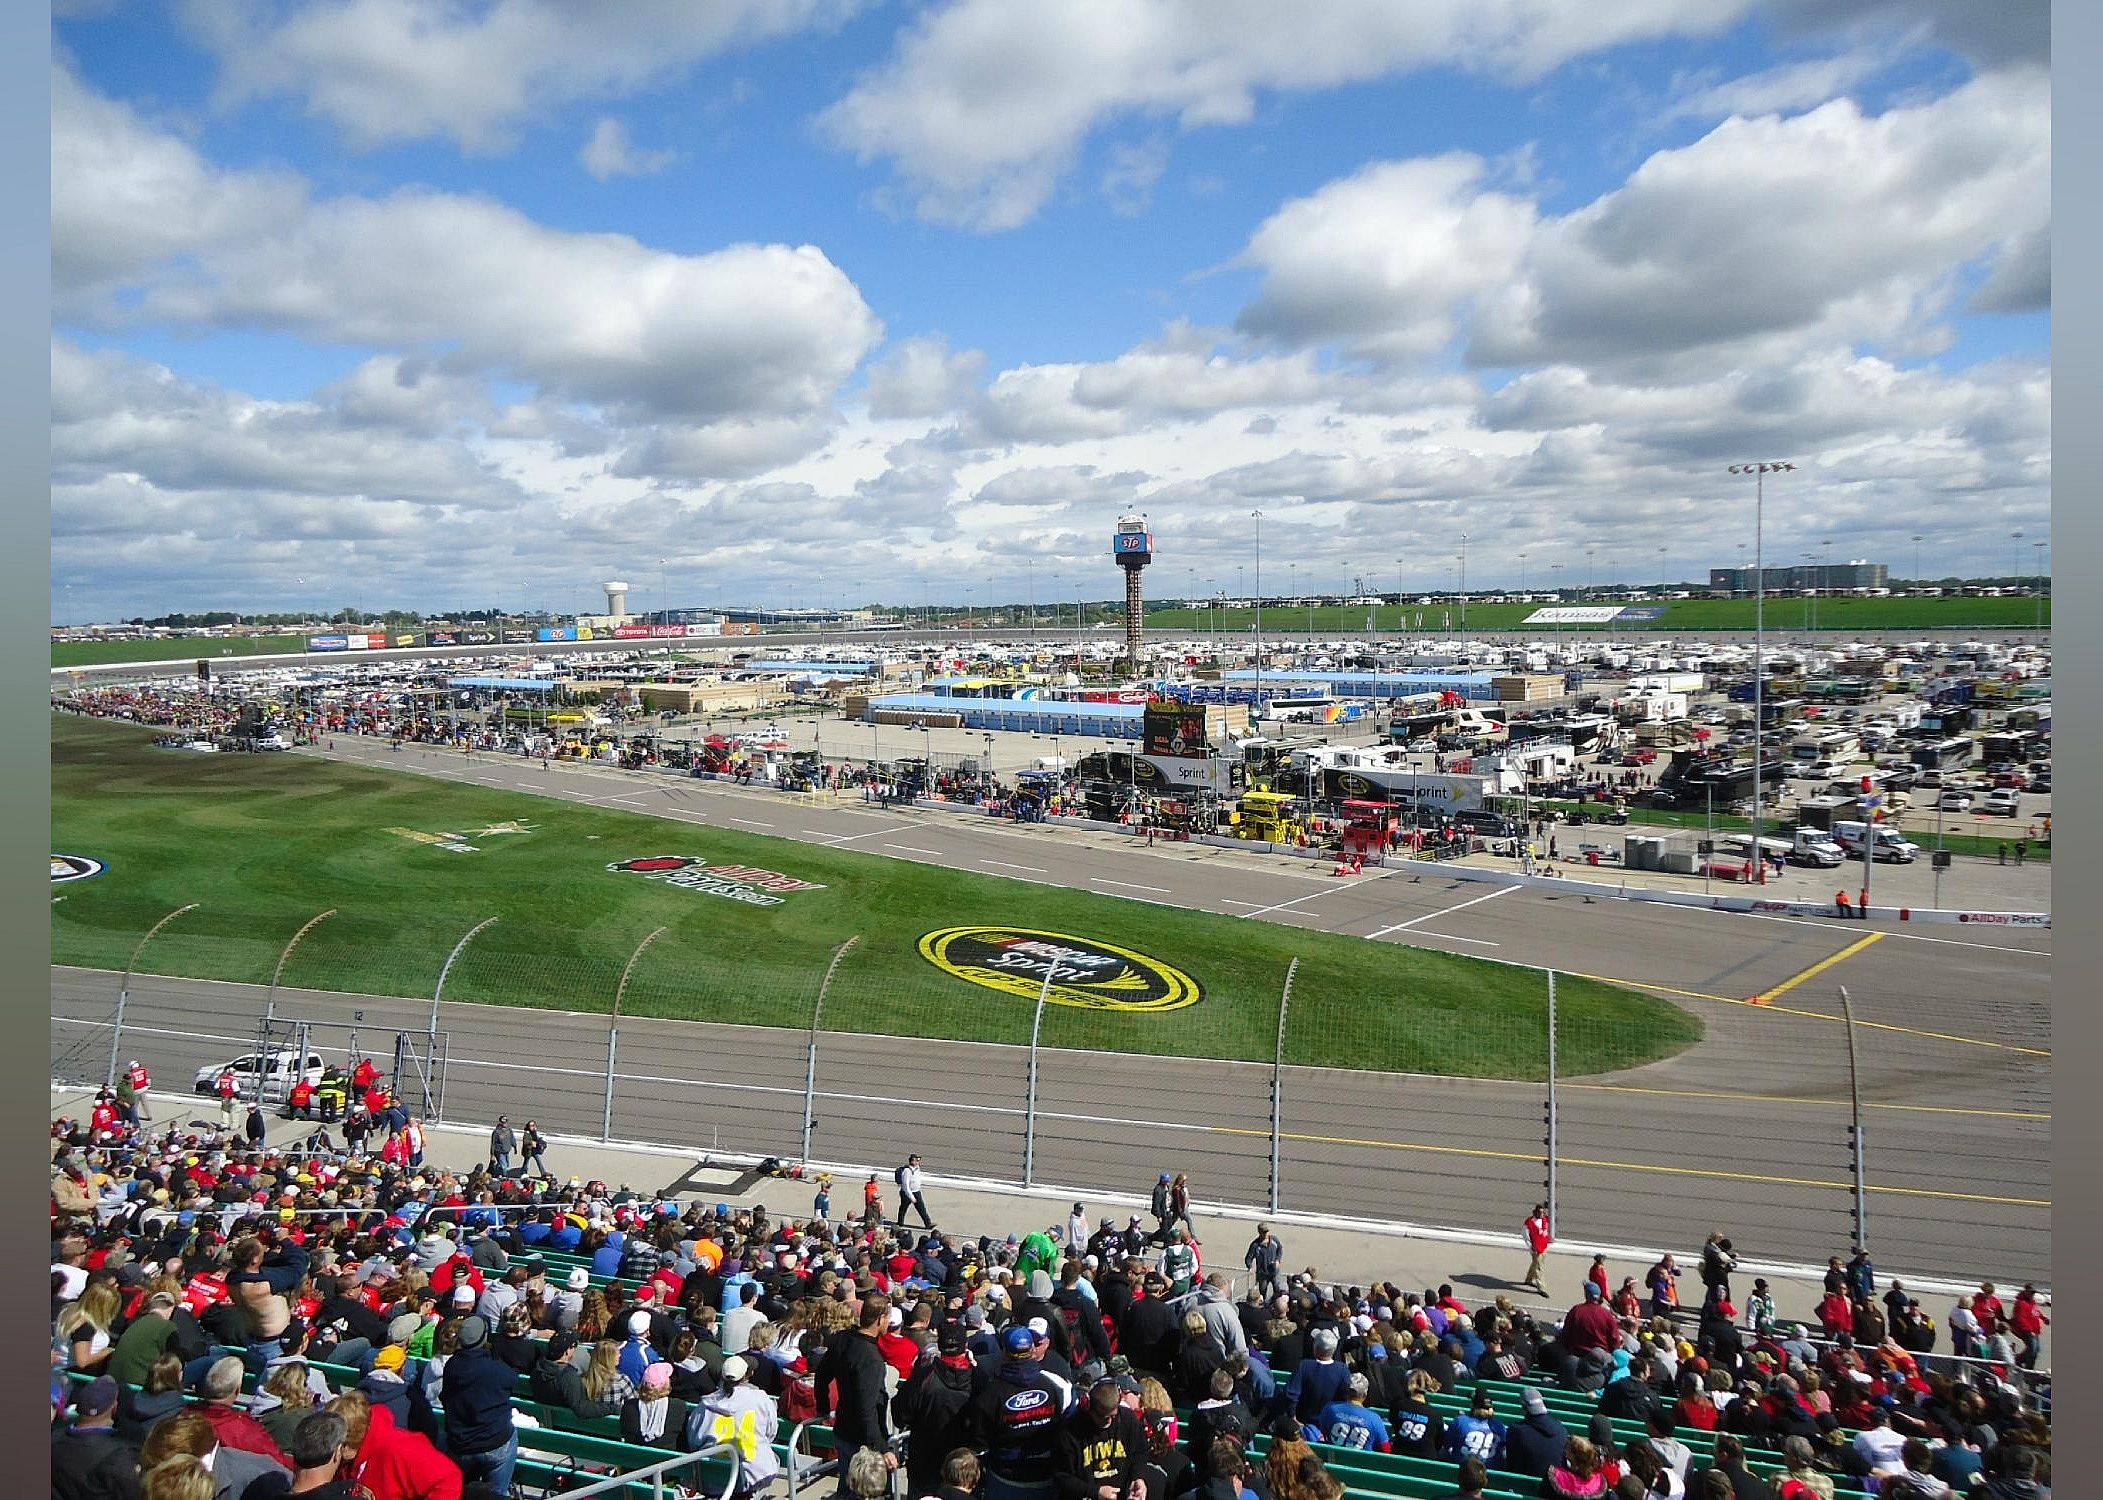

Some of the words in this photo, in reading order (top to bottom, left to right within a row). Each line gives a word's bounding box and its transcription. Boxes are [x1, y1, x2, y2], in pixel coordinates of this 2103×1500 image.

[1122, 535, 1139, 548] STP
[1533, 609, 1611, 619] Kansas
[468, 634, 487, 643] Sprint
[1178, 766, 1205, 779] Sprint
[1971, 913, 2010, 924] AllDay
[2012, 915, 2042, 924] Parts
[1006, 941, 1117, 967] NASCAR
[986, 952, 1099, 980] Sprint
[355, 1011, 363, 1020] 12
[1015, 1393, 1040, 1407] Ford
[714, 1410, 757, 1462] 24
[1400, 1420, 1427, 1441] 99
